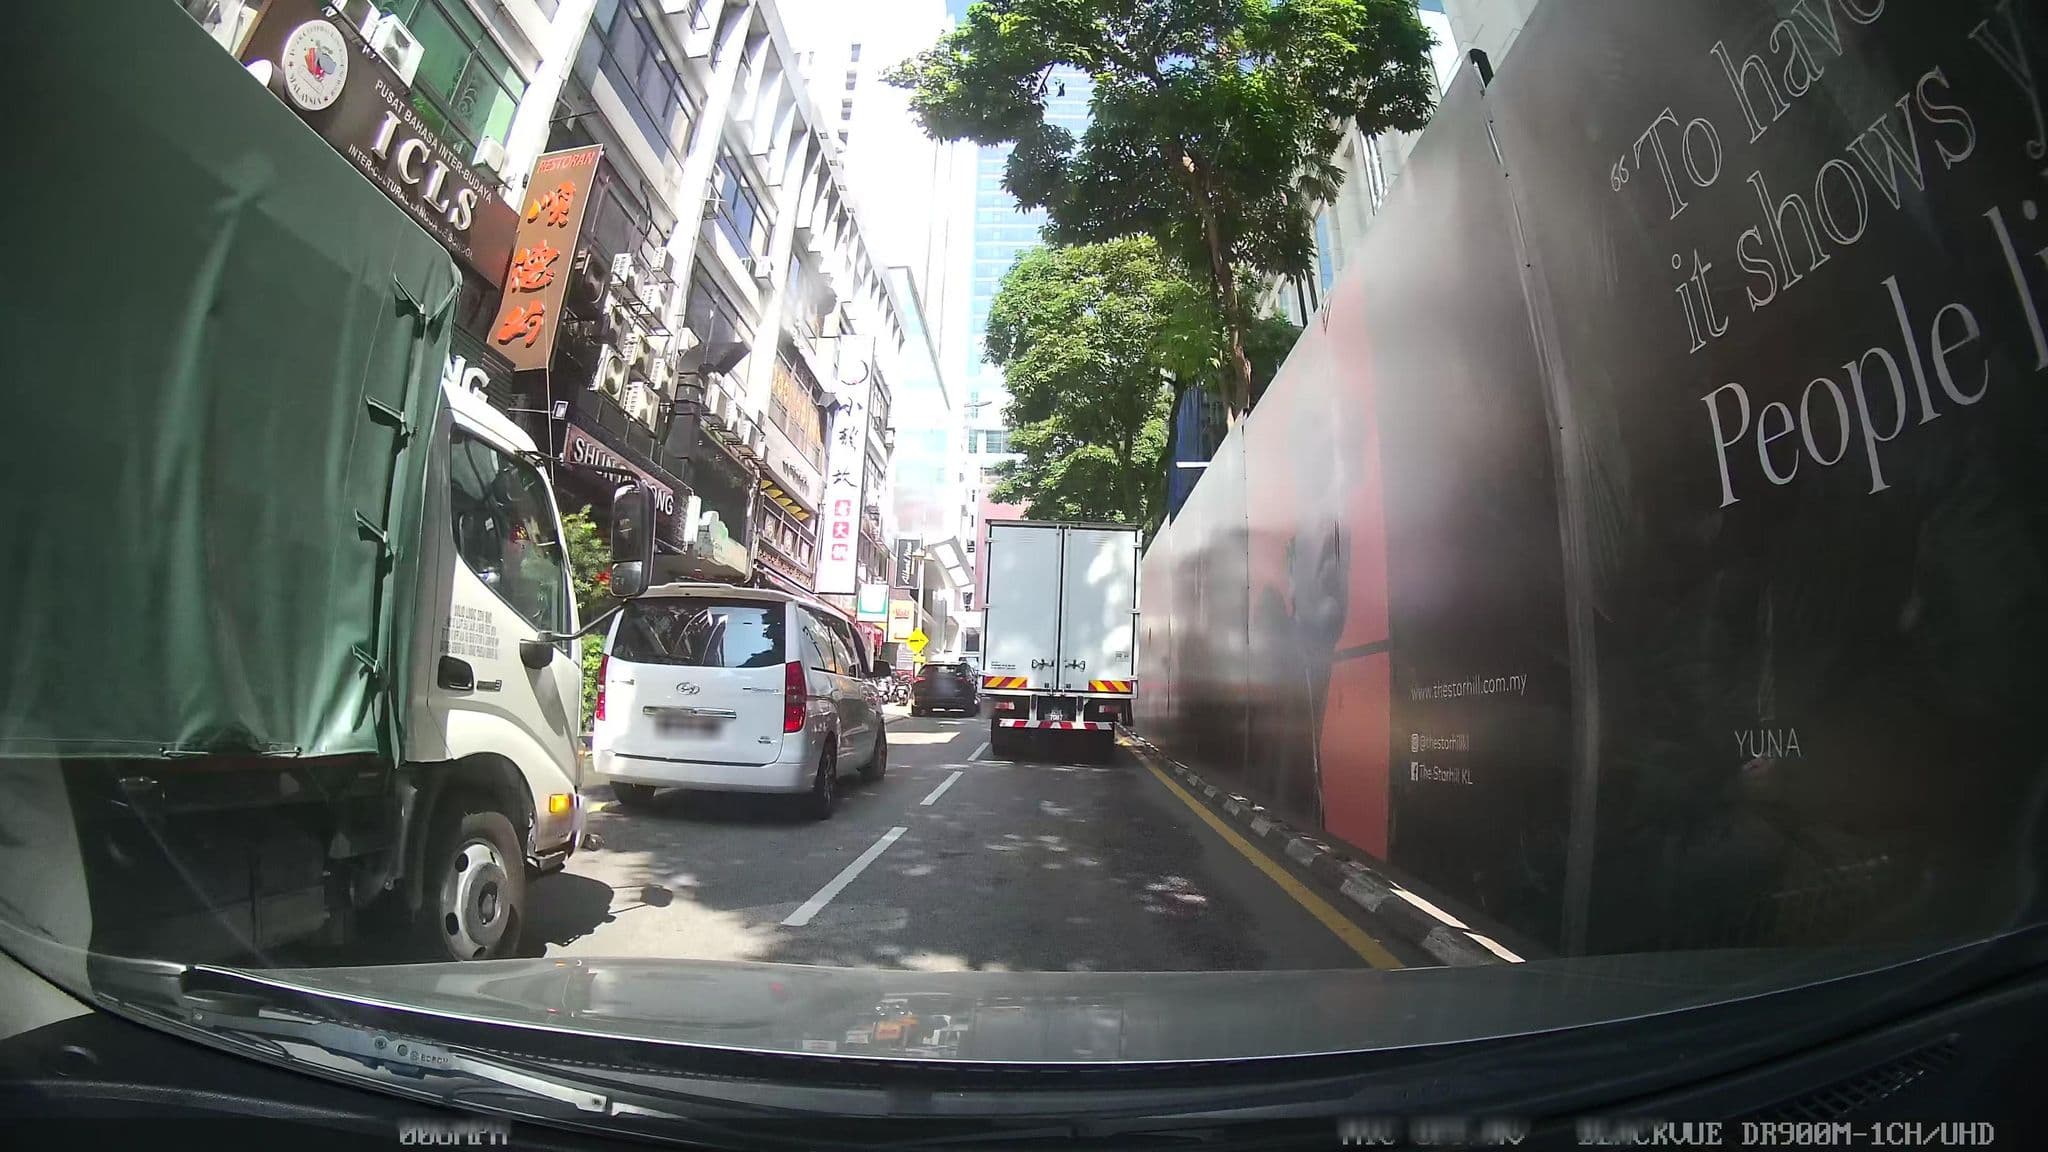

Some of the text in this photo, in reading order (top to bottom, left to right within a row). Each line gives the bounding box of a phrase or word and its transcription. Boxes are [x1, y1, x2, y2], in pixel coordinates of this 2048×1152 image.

[1710, 0, 1885, 144] hav
[370, 110, 478, 231] ICLS
[374, 79, 492, 206] PUSAT BAHASA INTER-BUDAYA
[537, 150, 597, 174] RESTORAN
[1671, 248, 1729, 354] it
[1736, 65, 1976, 312] shows
[1700, 274, 1990, 508] People
[1734, 727, 1801, 759] YUNA
